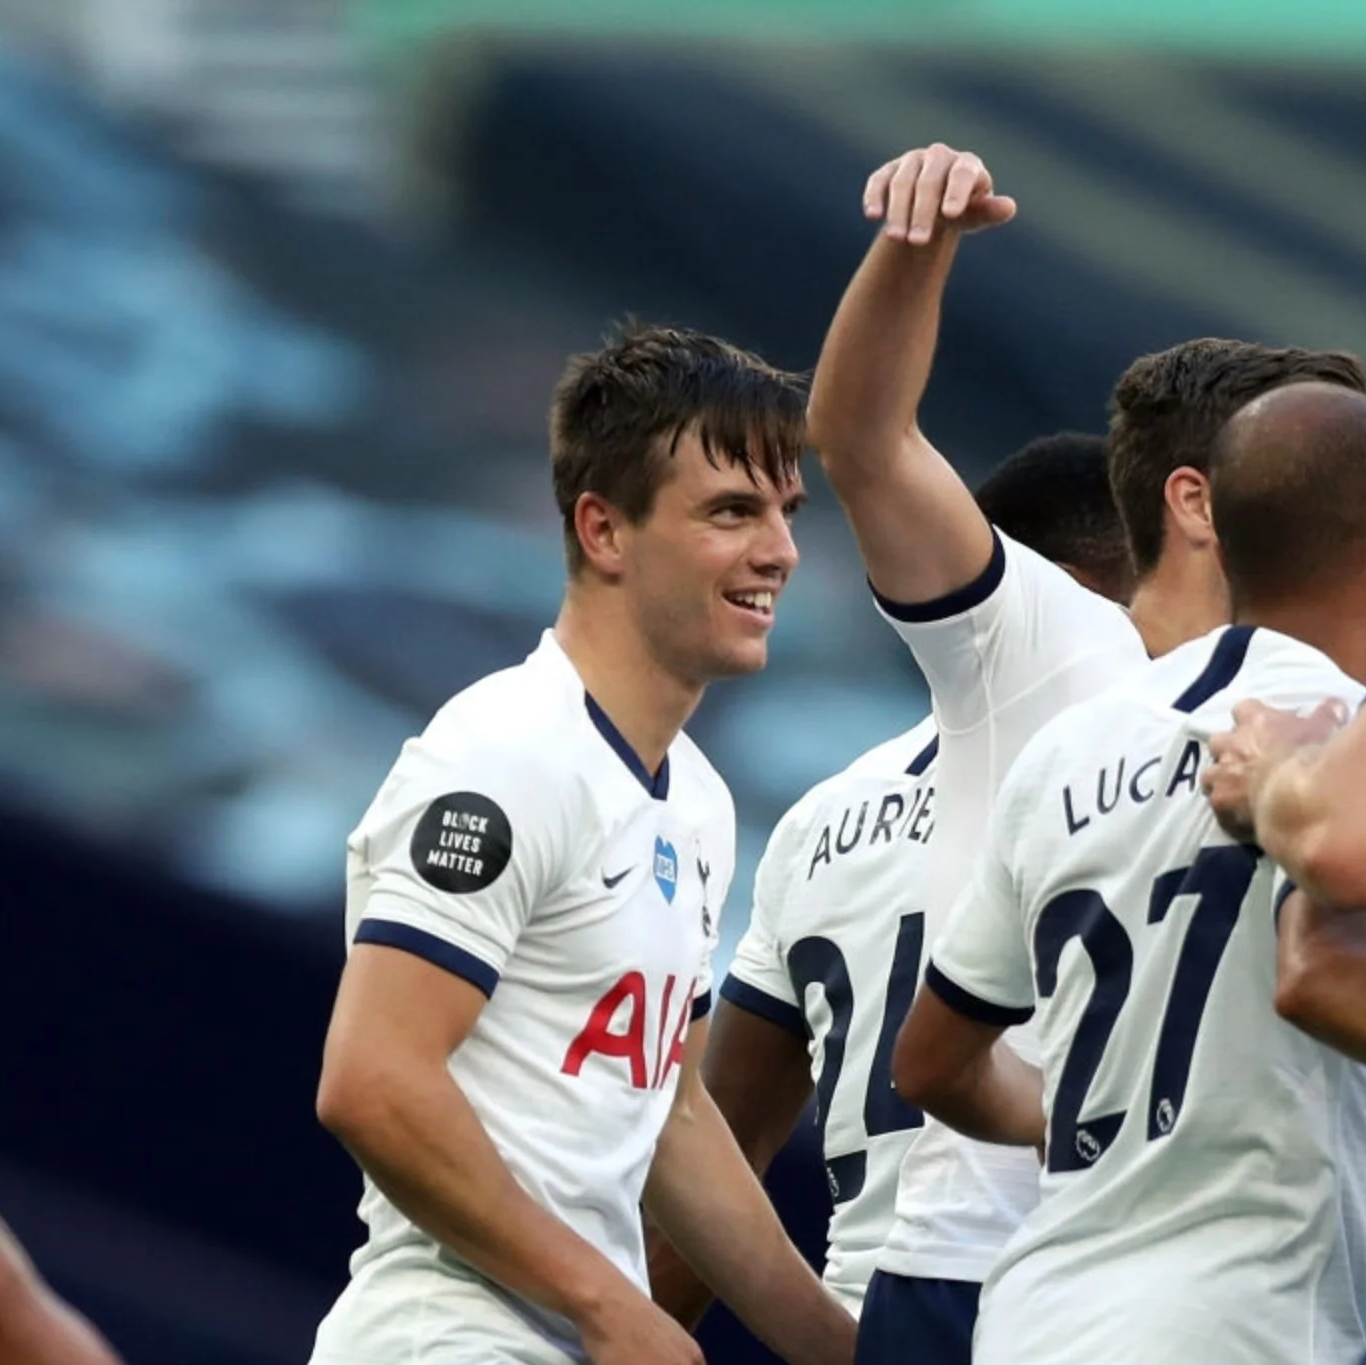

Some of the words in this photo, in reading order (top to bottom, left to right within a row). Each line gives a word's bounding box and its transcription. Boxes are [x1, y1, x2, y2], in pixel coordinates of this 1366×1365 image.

[439, 830, 481, 853] LIVES
[426, 849, 484, 876] MATTER
[1033, 844, 1260, 1174] 27
